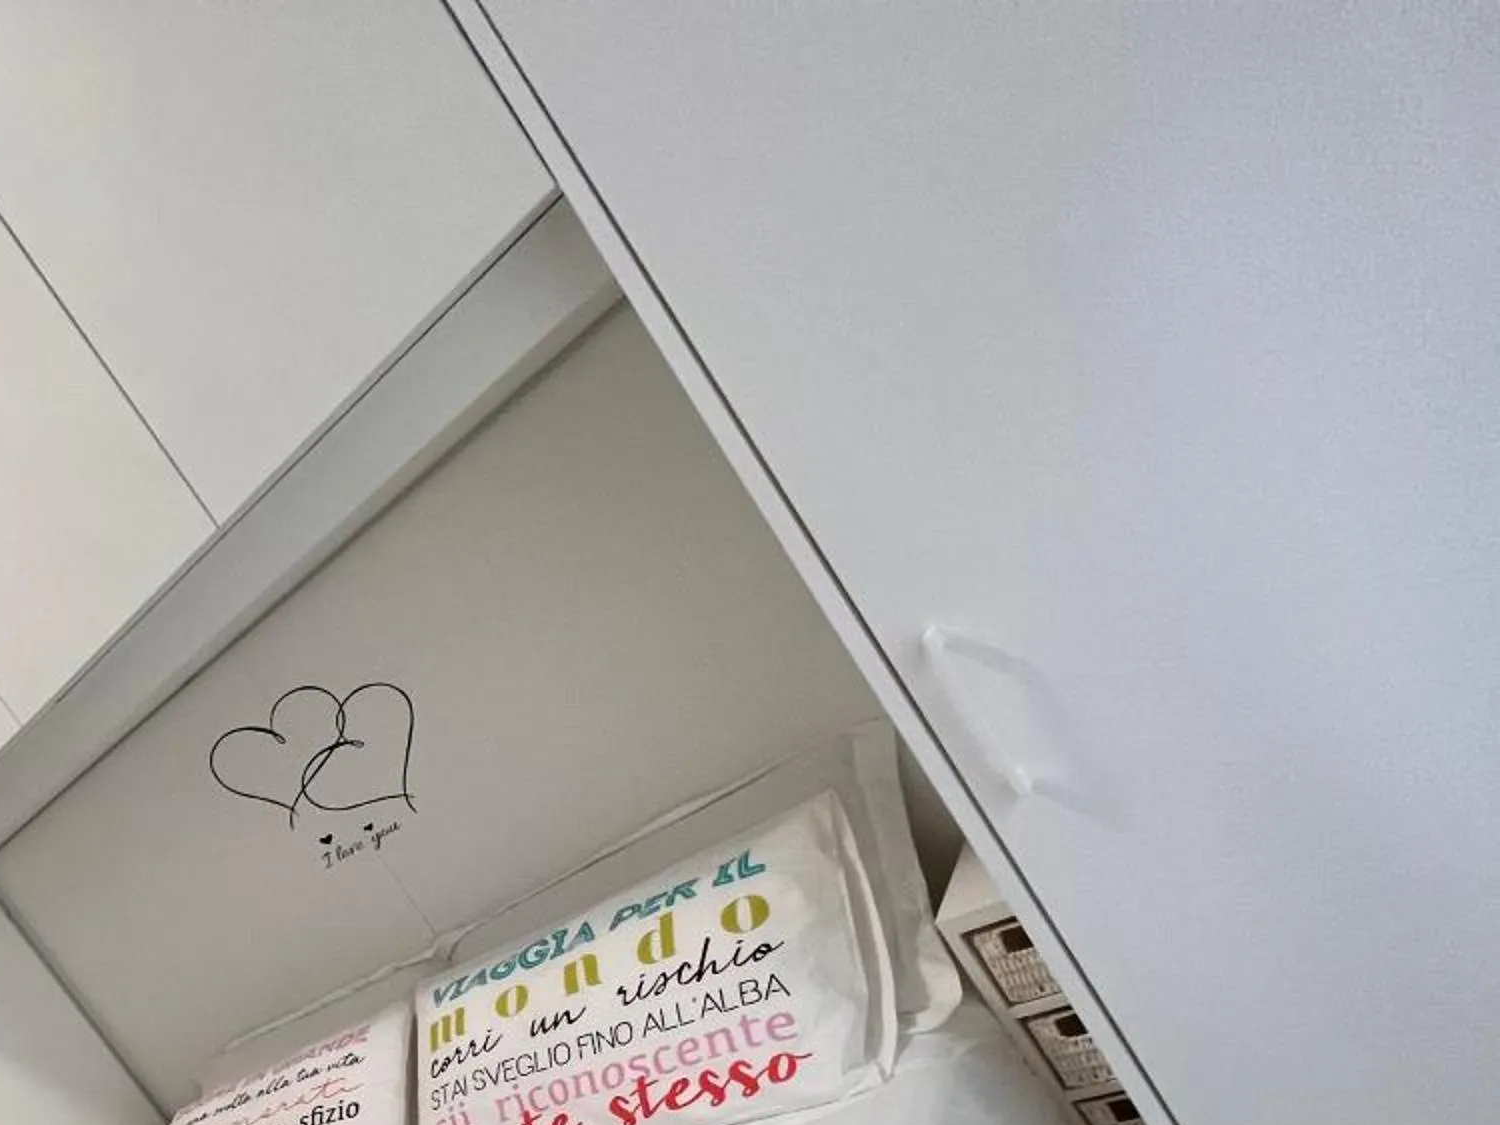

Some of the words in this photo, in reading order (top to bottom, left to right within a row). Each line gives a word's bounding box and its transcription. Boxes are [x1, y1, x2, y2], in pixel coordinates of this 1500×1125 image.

[433, 920, 595, 1008] VIAGGIA
[609, 877, 699, 931] PER
[712, 847, 766, 887] IL
[431, 1028, 503, 1069] corri
[530, 1005, 587, 1038] un
[616, 936, 785, 1006] rischio
[431, 1064, 468, 1111] STAI
[472, 1040, 572, 1091] SVEGLIO
[577, 1020, 634, 1060] FINO
[642, 973, 791, 1038] ALL'ALBA
[495, 1011, 798, 1122] riconoscente
